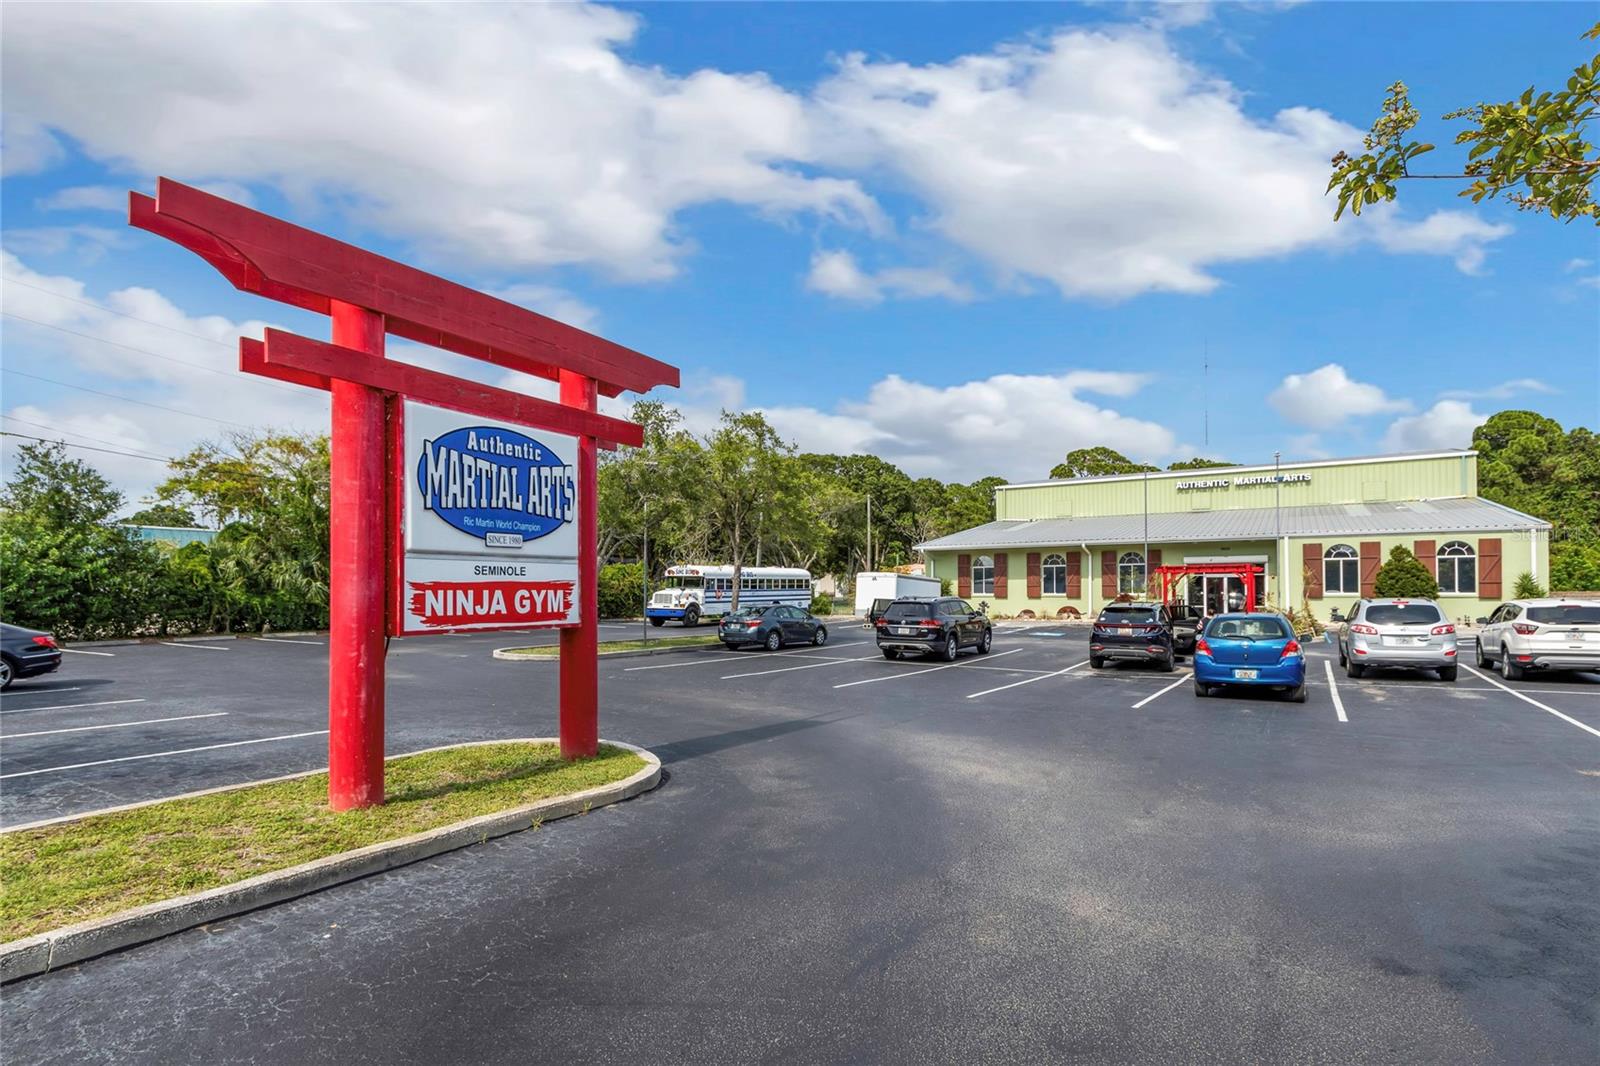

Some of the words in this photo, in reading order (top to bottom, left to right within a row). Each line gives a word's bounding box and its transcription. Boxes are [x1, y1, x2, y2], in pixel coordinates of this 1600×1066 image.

[468, 431, 542, 461] Authentic
[424, 440, 523, 512] MARTIAL
[527, 465, 574, 522] ARTS
[1176, 479, 1229, 489] AUTHENTIC
[1233, 476, 1279, 486] MARTIAL
[1282, 473, 1312, 482] ARTS
[464, 516, 474, 527] Ric
[475, 517, 495, 529] Martin
[495, 519, 513, 531] World
[513, 521, 542, 533] Champion
[487, 535, 508, 545] SINCE
[508, 536, 522, 546] 1980
[474, 565, 527, 576] SEMINOLE
[424, 589, 507, 617] NINJA
[514, 589, 564, 614] GYM
